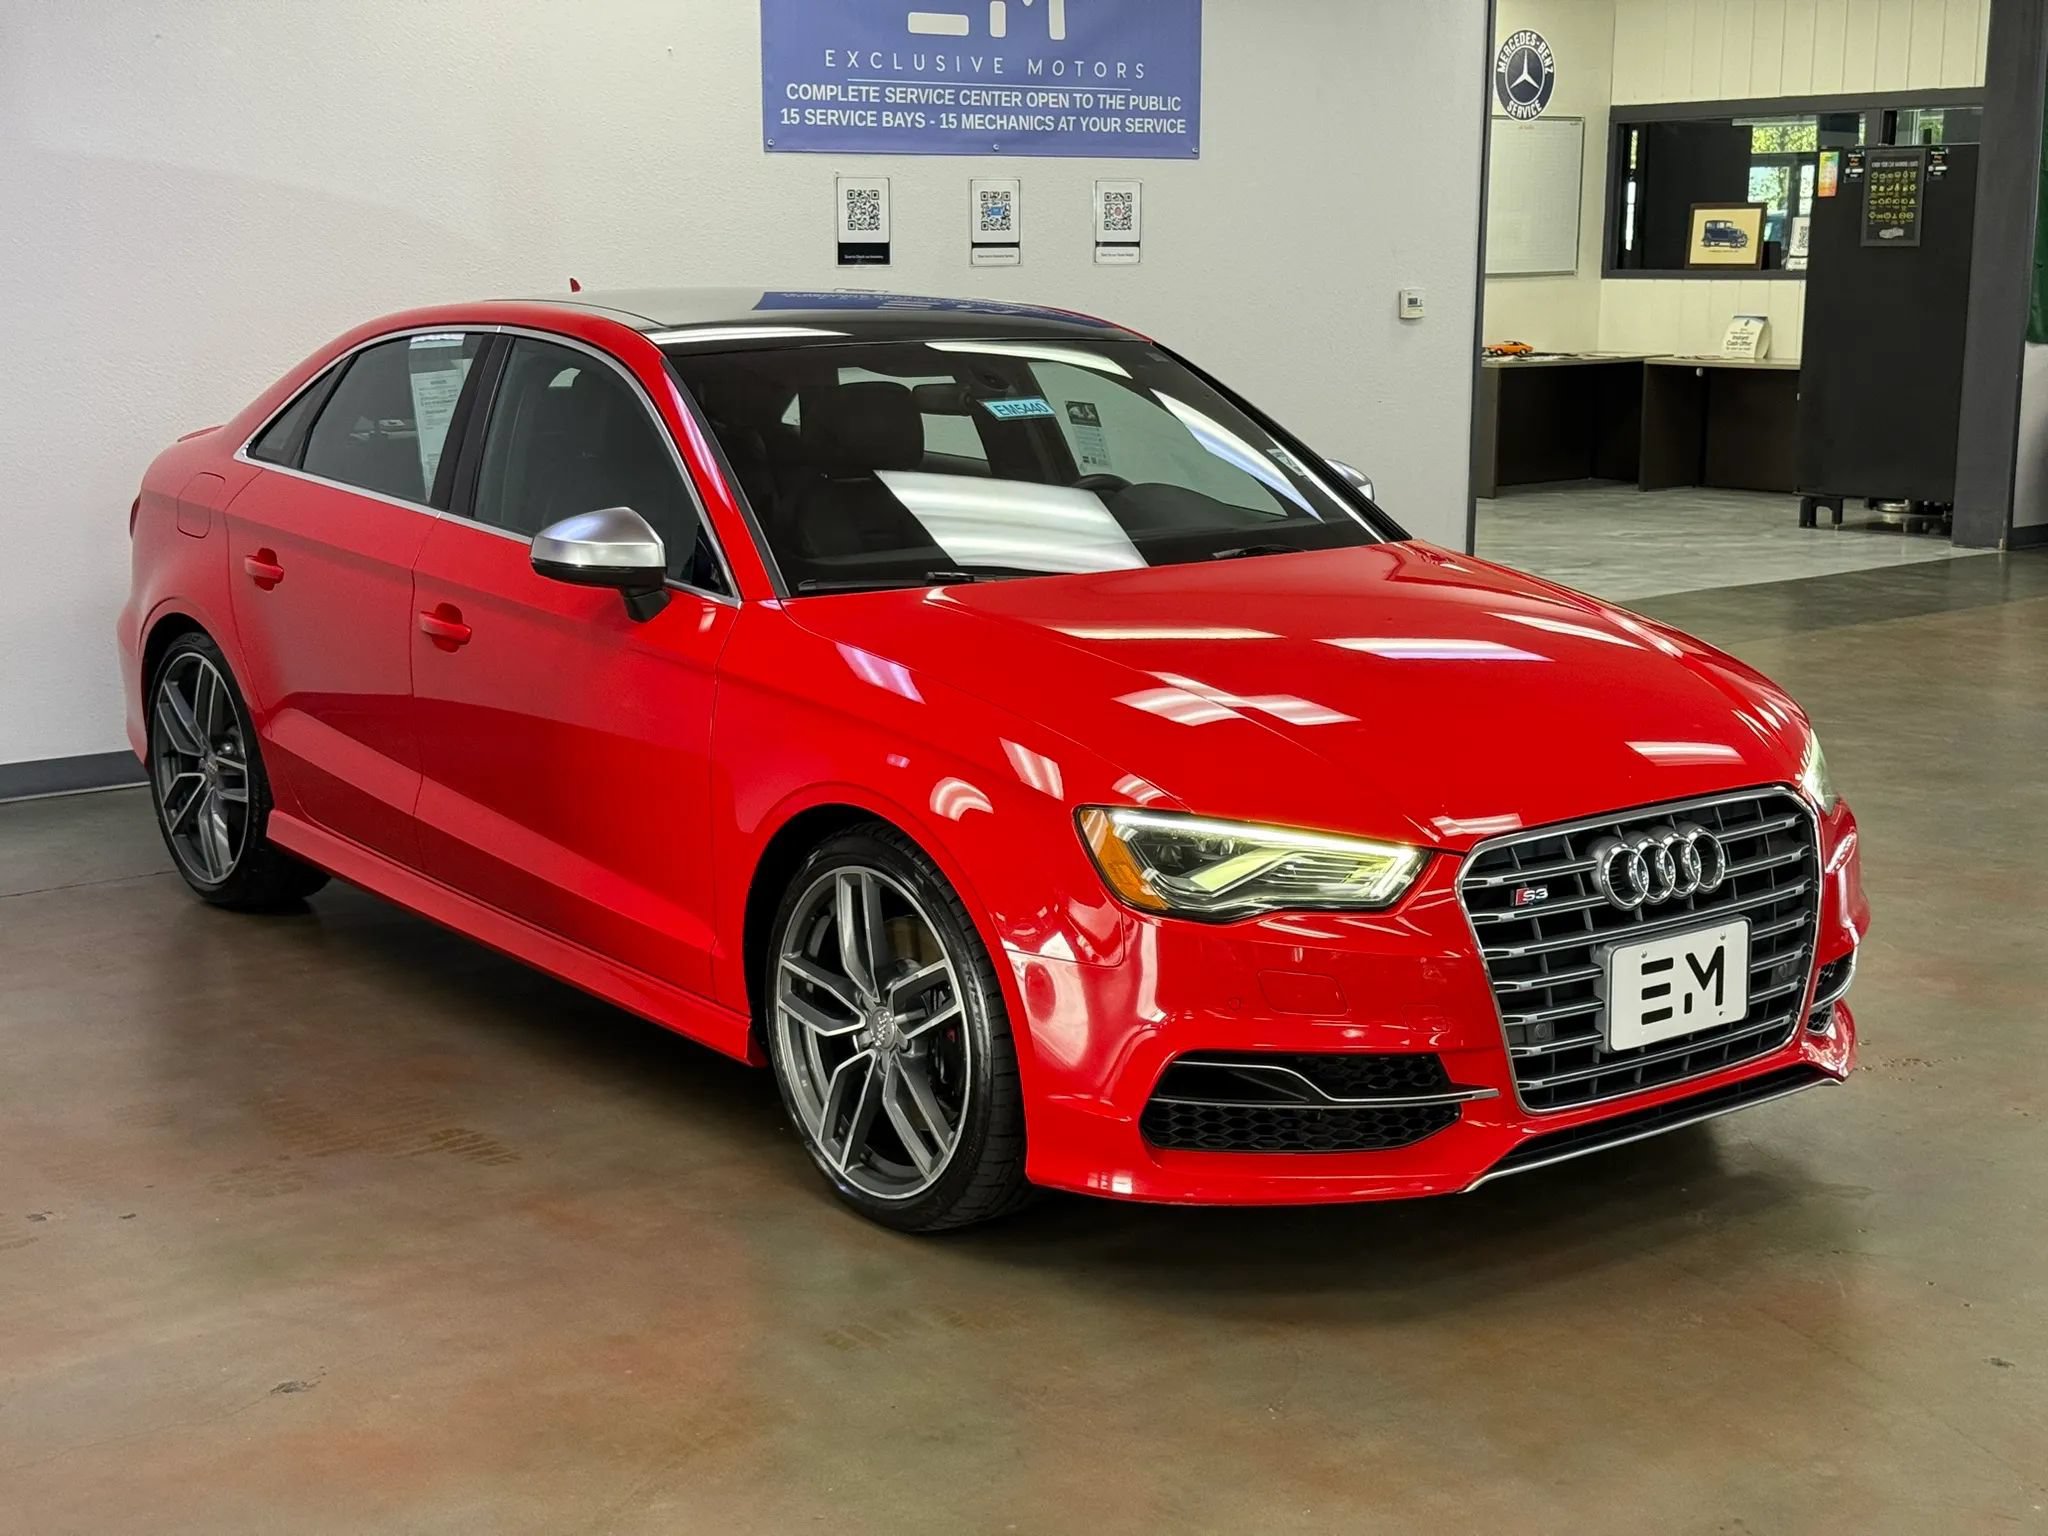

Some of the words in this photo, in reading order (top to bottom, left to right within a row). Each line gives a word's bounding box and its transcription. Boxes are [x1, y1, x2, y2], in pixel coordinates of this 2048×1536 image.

[825, 49, 1003, 74] EXCLUSIVE
[1027, 58, 1145, 79] MOTORS
[1497, 32, 1554, 74] MERCEDES-BENZ
[786, 83, 880, 103] COMPLETE
[884, 86, 955, 105] SERVICE
[959, 90, 1022, 107] CENTER
[1026, 92, 1069, 108] OPEN
[1073, 93, 1093, 109] TO
[1097, 94, 1125, 110] THE
[1129, 95, 1182, 112] PUBLIC
[1507, 100, 1542, 119] SERVICE
[780, 108, 800, 125] 15
[804, 108, 877, 127] SERVICE
[882, 111, 925, 129] BAYS
[939, 113, 957, 129] 15
[961, 114, 1054, 131] MECHANICS
[1057, 116, 1076, 132] AT
[1080, 116, 1121, 132] YOUR
[1125, 117, 1186, 134] SERVICE
[1522, 887, 1549, 902] S3
[1641, 945, 1725, 1026] EM
